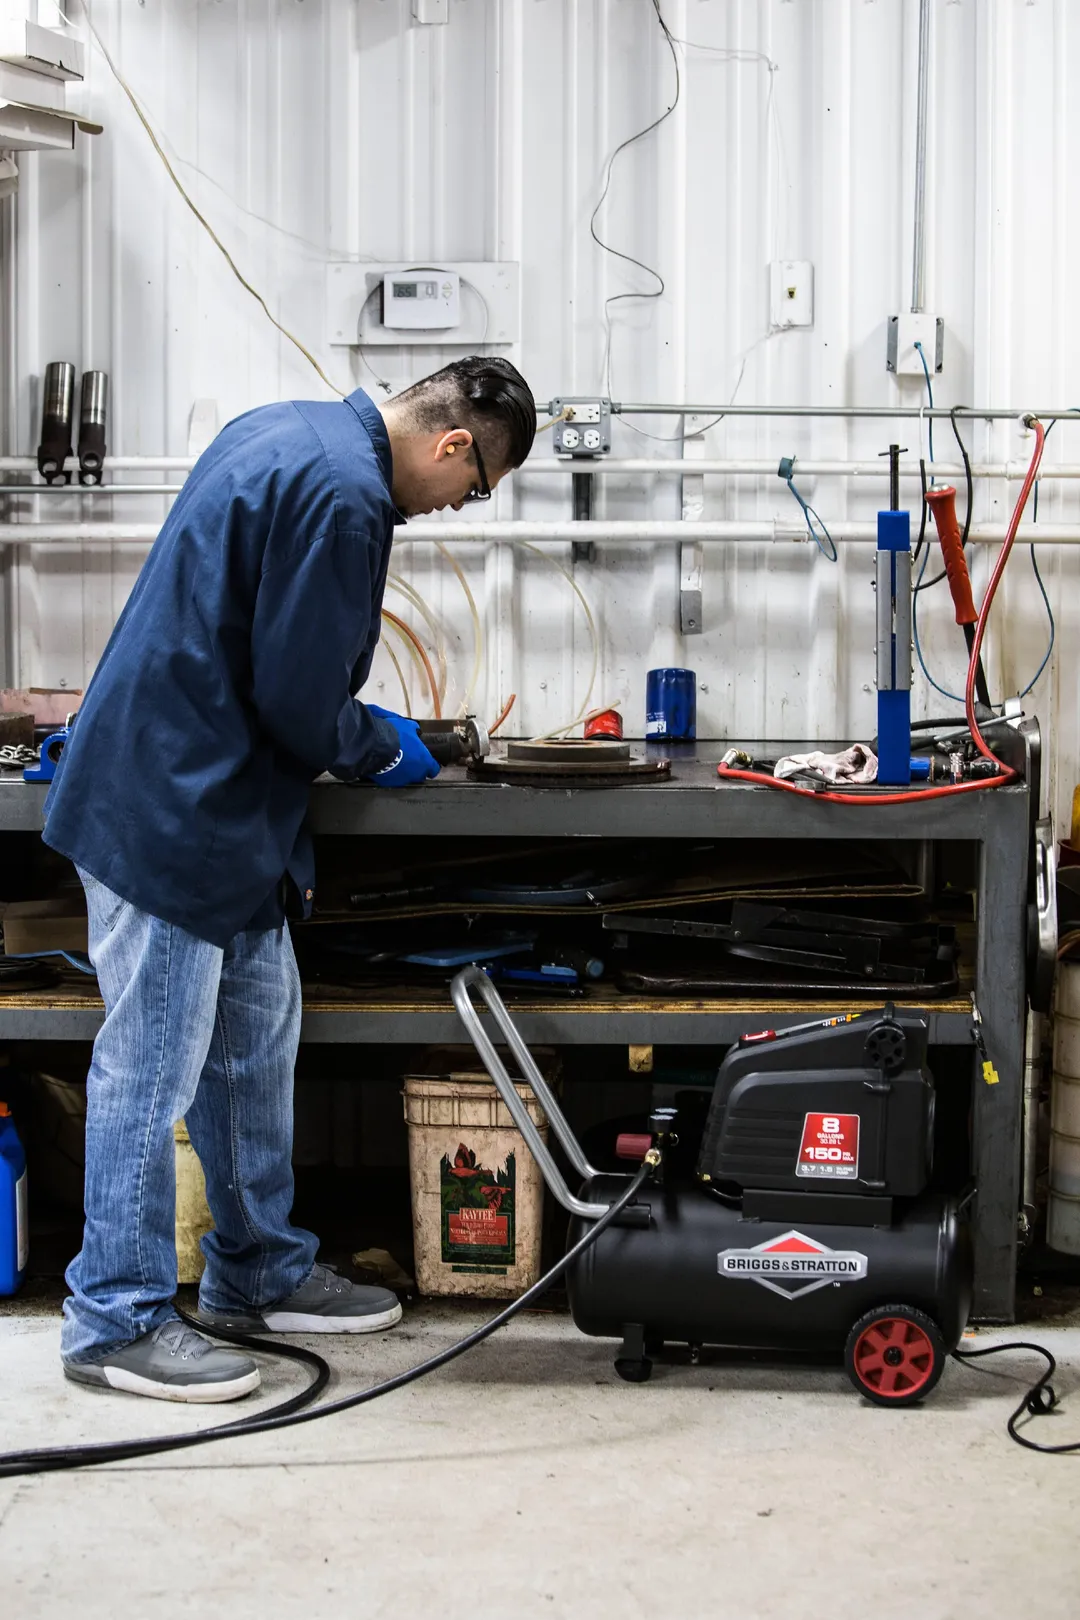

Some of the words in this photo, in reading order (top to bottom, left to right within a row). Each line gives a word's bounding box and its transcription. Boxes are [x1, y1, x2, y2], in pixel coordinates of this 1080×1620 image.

[822, 1117, 840, 1133] 8
[804, 1147, 842, 1160] 150
[463, 1209, 493, 1220] KAYTEE
